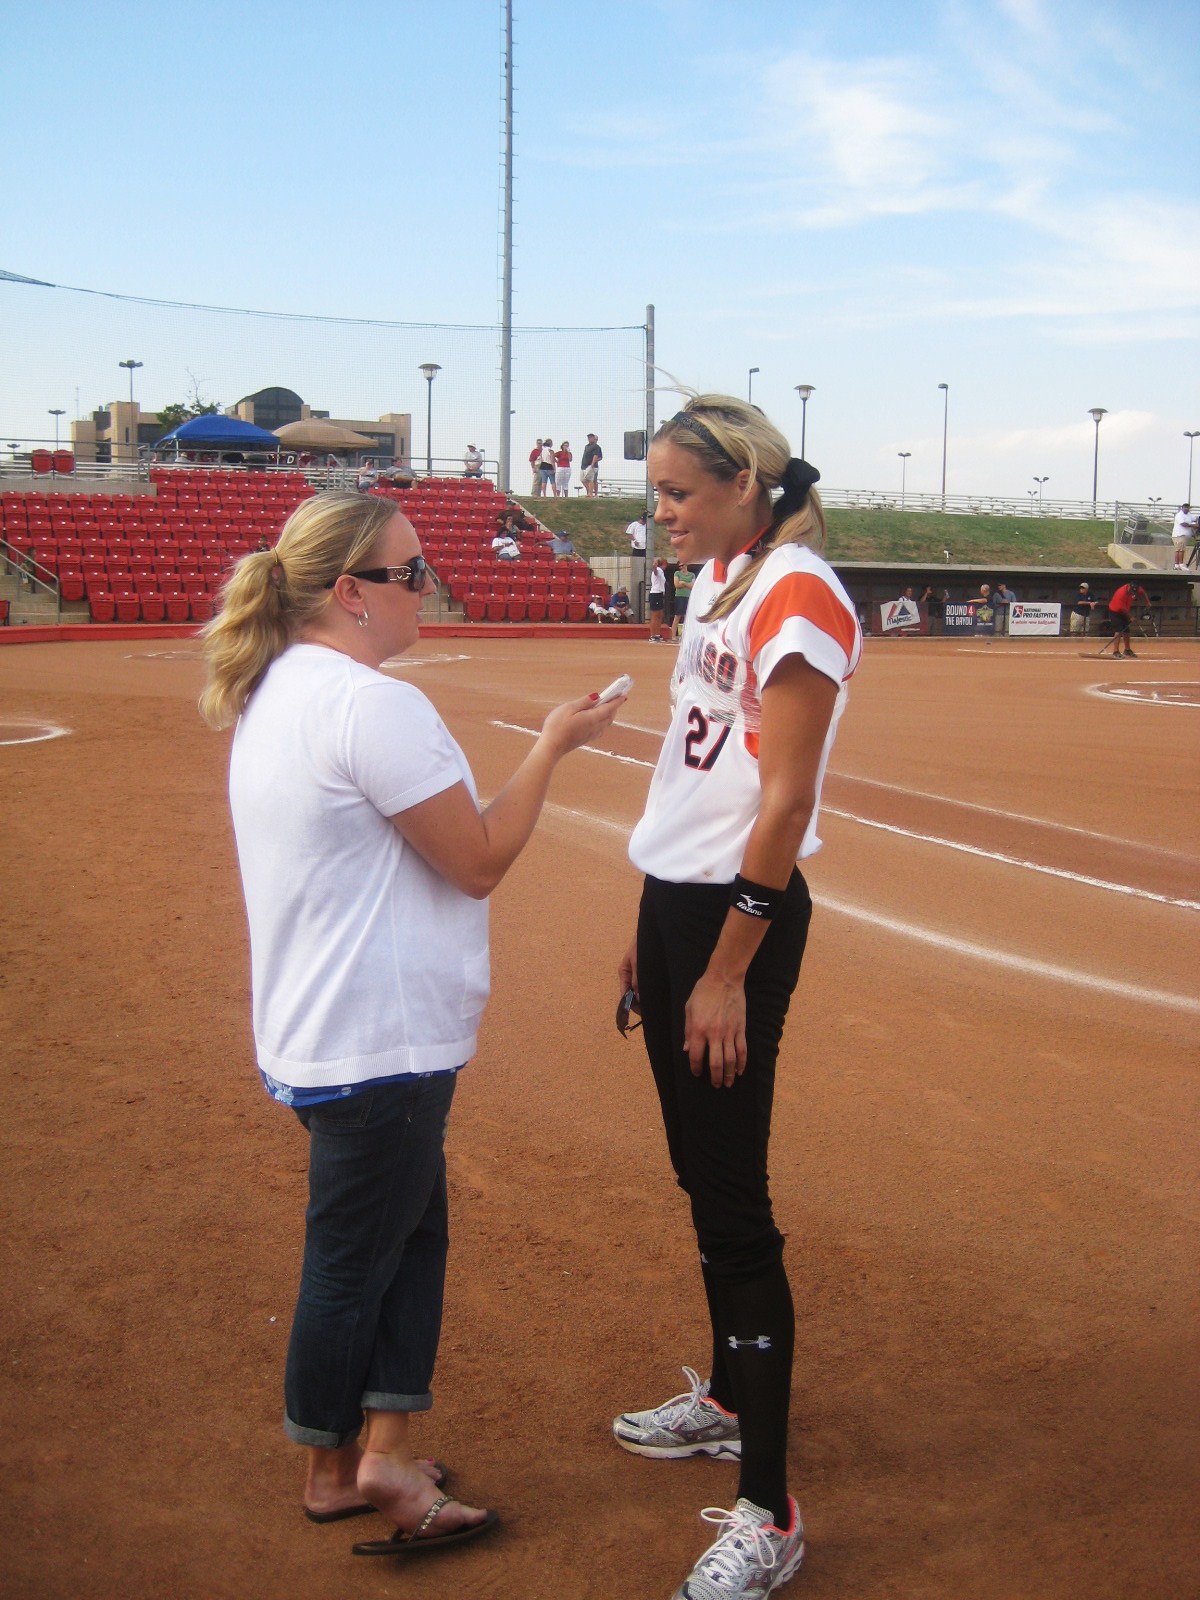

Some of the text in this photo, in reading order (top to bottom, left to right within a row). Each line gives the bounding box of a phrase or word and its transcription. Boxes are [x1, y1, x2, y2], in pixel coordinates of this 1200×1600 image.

[287, 455, 295, 464] D
[946, 604, 974, 616] BOUND 4
[945, 616, 973, 626] THE BAYOU
[684, 706, 736, 771] 27
